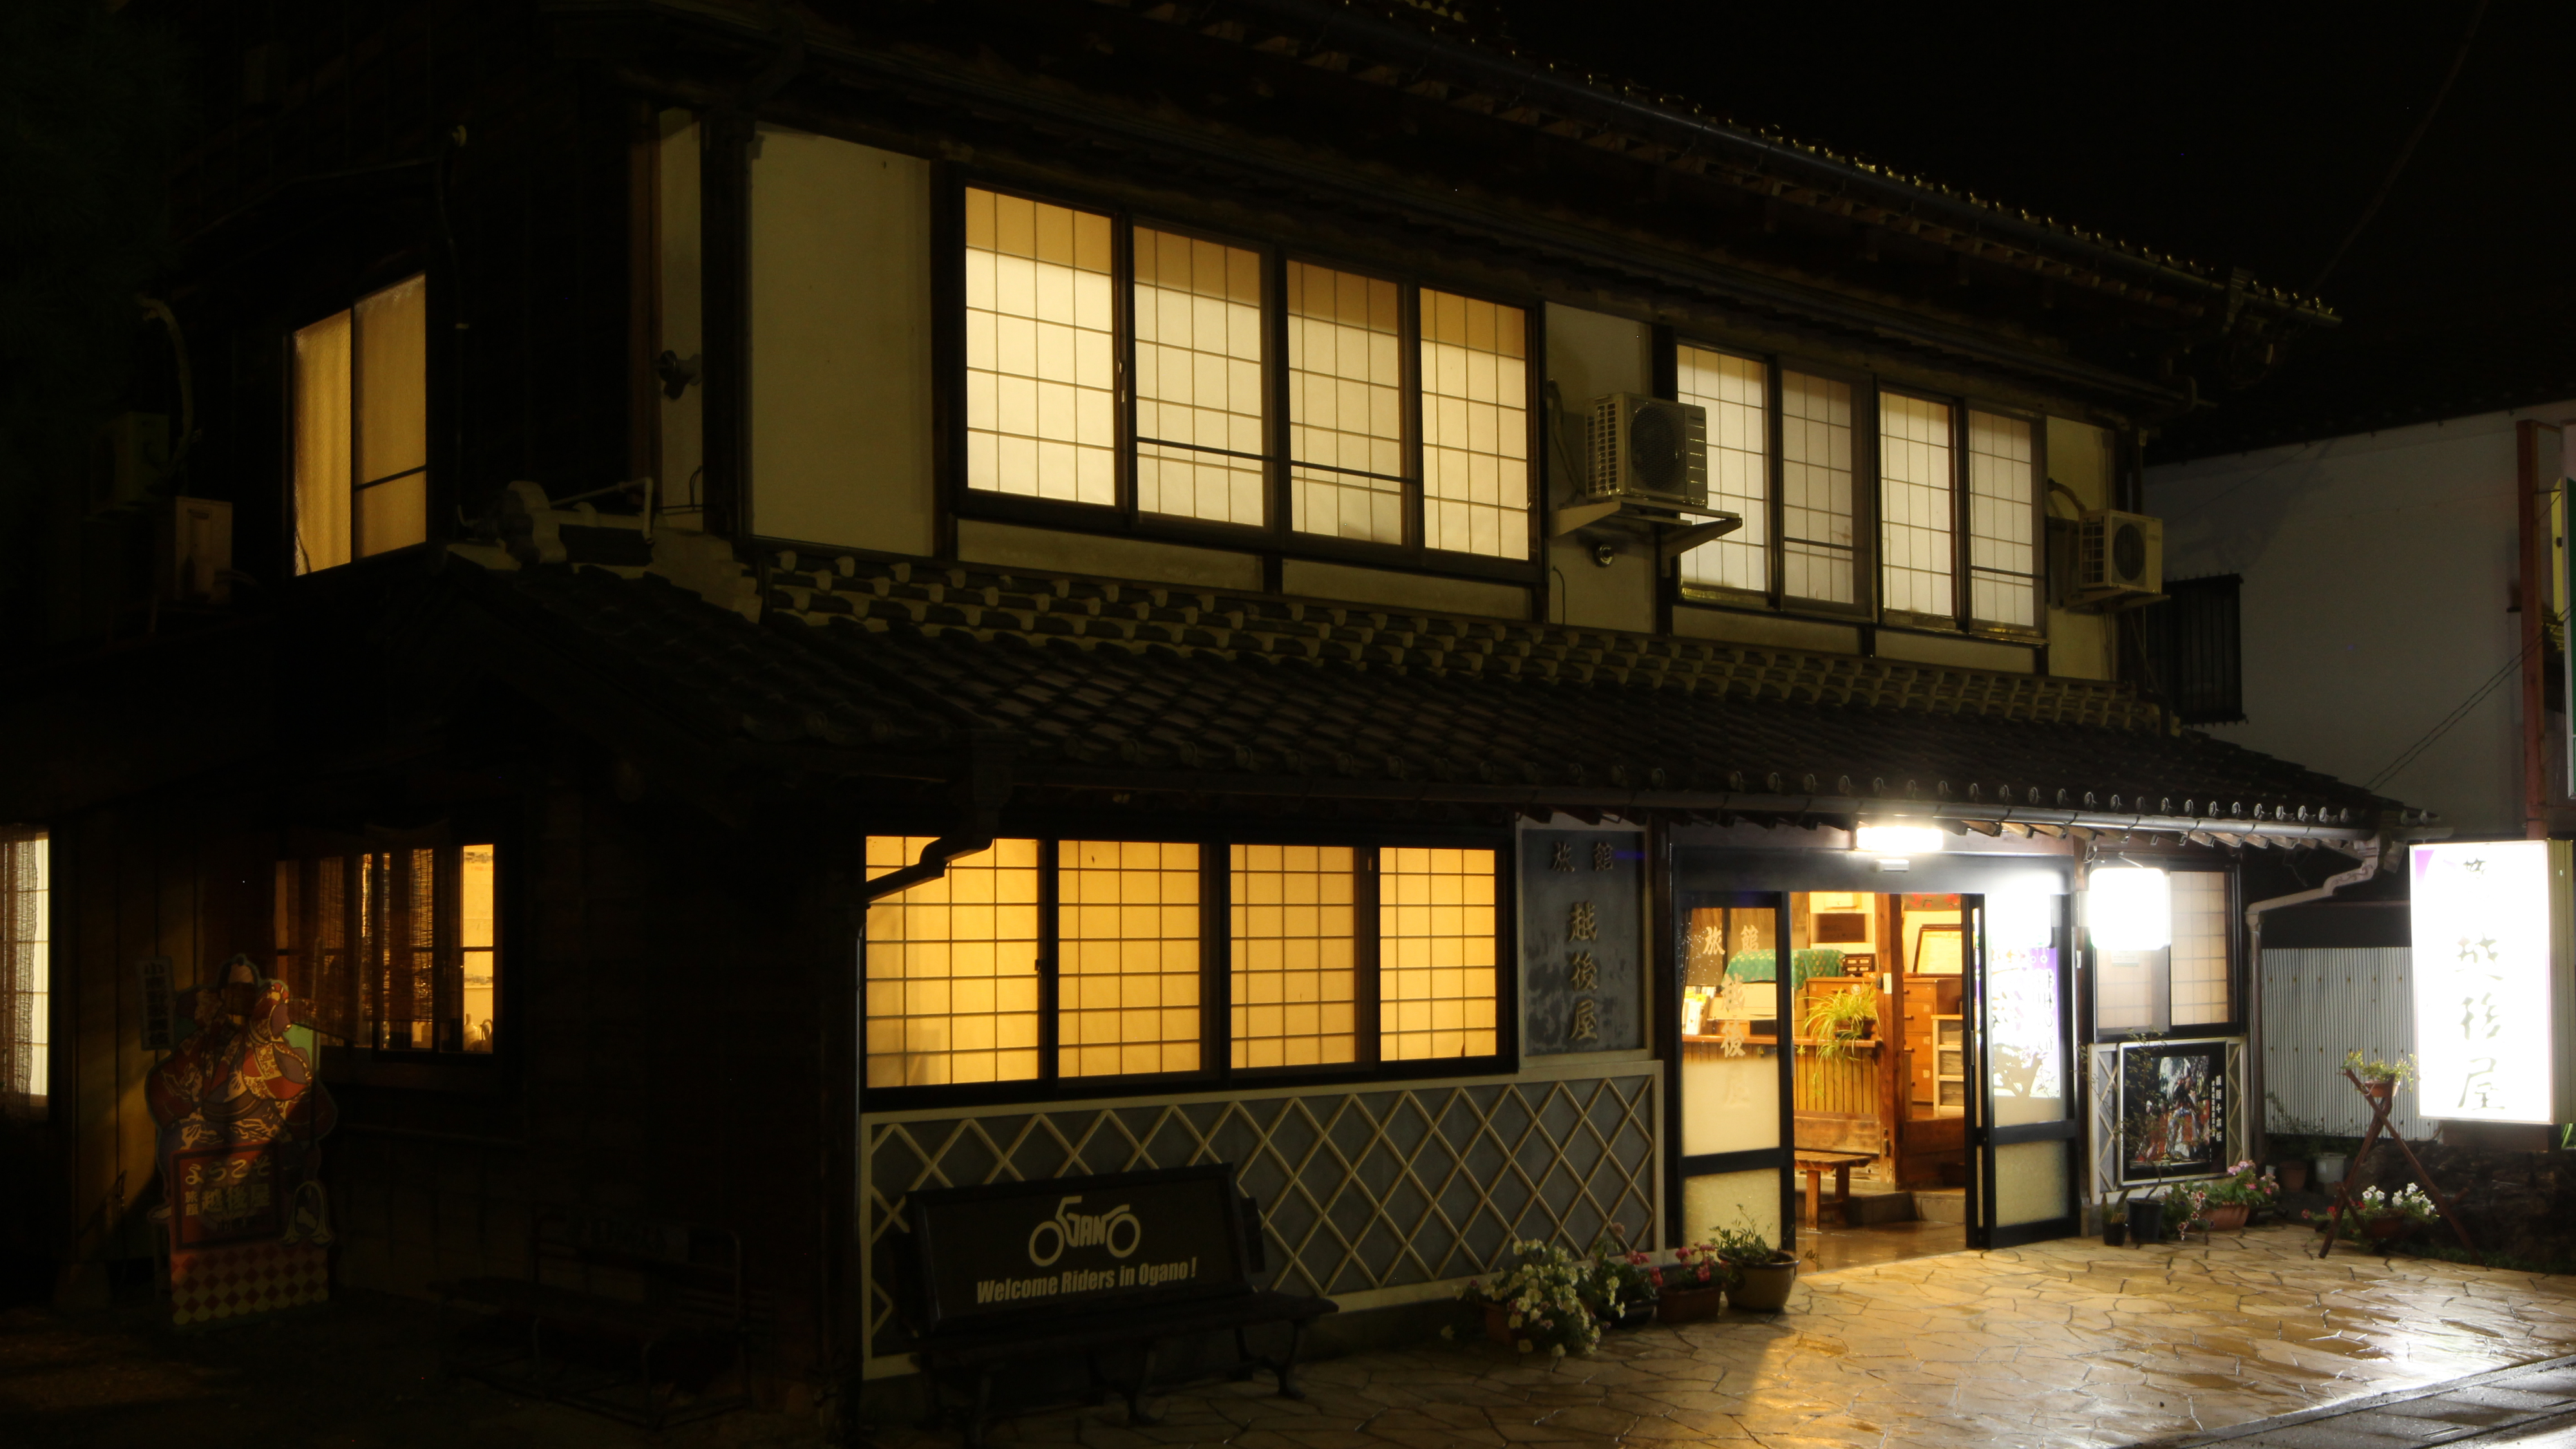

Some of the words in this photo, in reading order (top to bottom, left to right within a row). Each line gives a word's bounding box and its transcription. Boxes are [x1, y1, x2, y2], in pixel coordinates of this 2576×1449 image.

[1550, 840, 1613, 872] 旅館
[1703, 925, 1759, 956] 旅館
[1568, 901, 1598, 1041] 越後屋
[185, 1155, 271, 1185] ようこそ
[185, 1191, 199, 1216] 旅館
[202, 1183, 270, 1213] 越後屋
[977, 1275, 1057, 1303] Welcome
[1061, 1267, 1115, 1293] Riders
[1119, 1265, 1135, 1286] in
